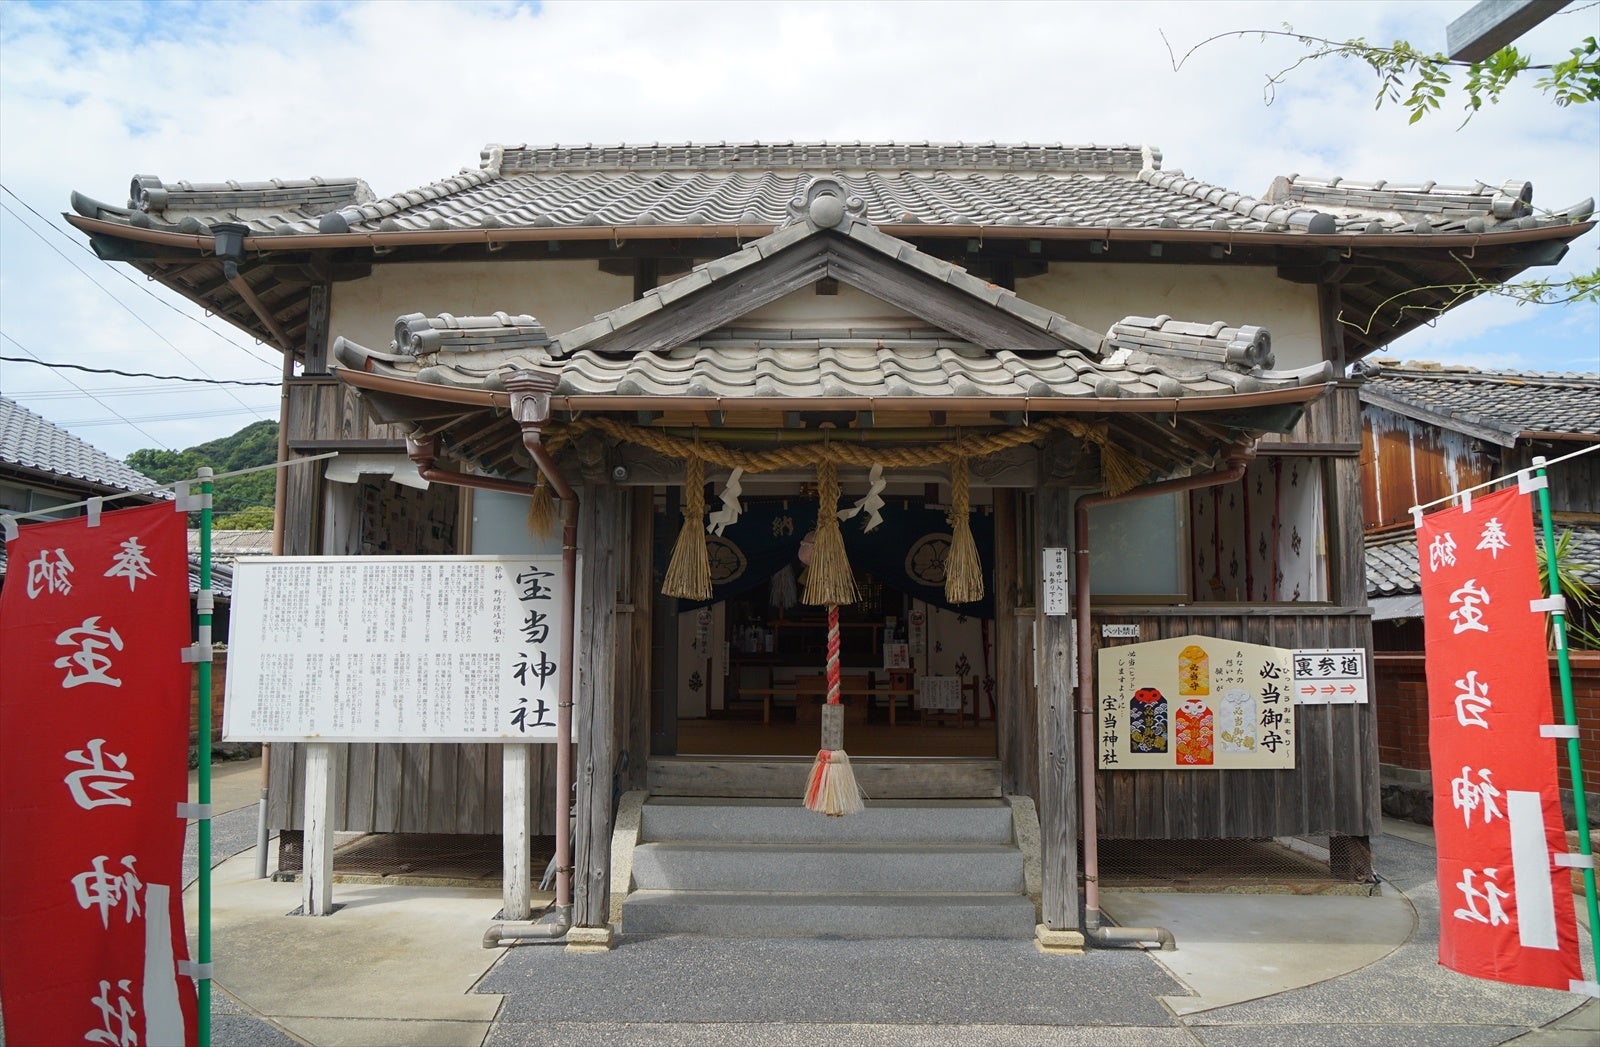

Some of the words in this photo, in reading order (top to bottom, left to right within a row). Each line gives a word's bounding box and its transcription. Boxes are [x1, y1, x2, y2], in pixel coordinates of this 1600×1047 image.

[1056, 550, 1064, 605] 神社の中に入って
[1104, 626, 1138, 636] ペット禁止
[510, 565, 558, 734] 宝当神社
[1296, 656, 1359, 676] 裏参道
[1189, 664, 1200, 691] 必当守
[1214, 668, 1224, 692] 願いが
[1226, 659, 1234, 684] 想いや
[1236, 650, 1244, 684] あなたの
[1259, 660, 1284, 754] 必当御守
[1102, 695, 1119, 766] 宝当神社
[1233, 707, 1244, 748] 必当御守
